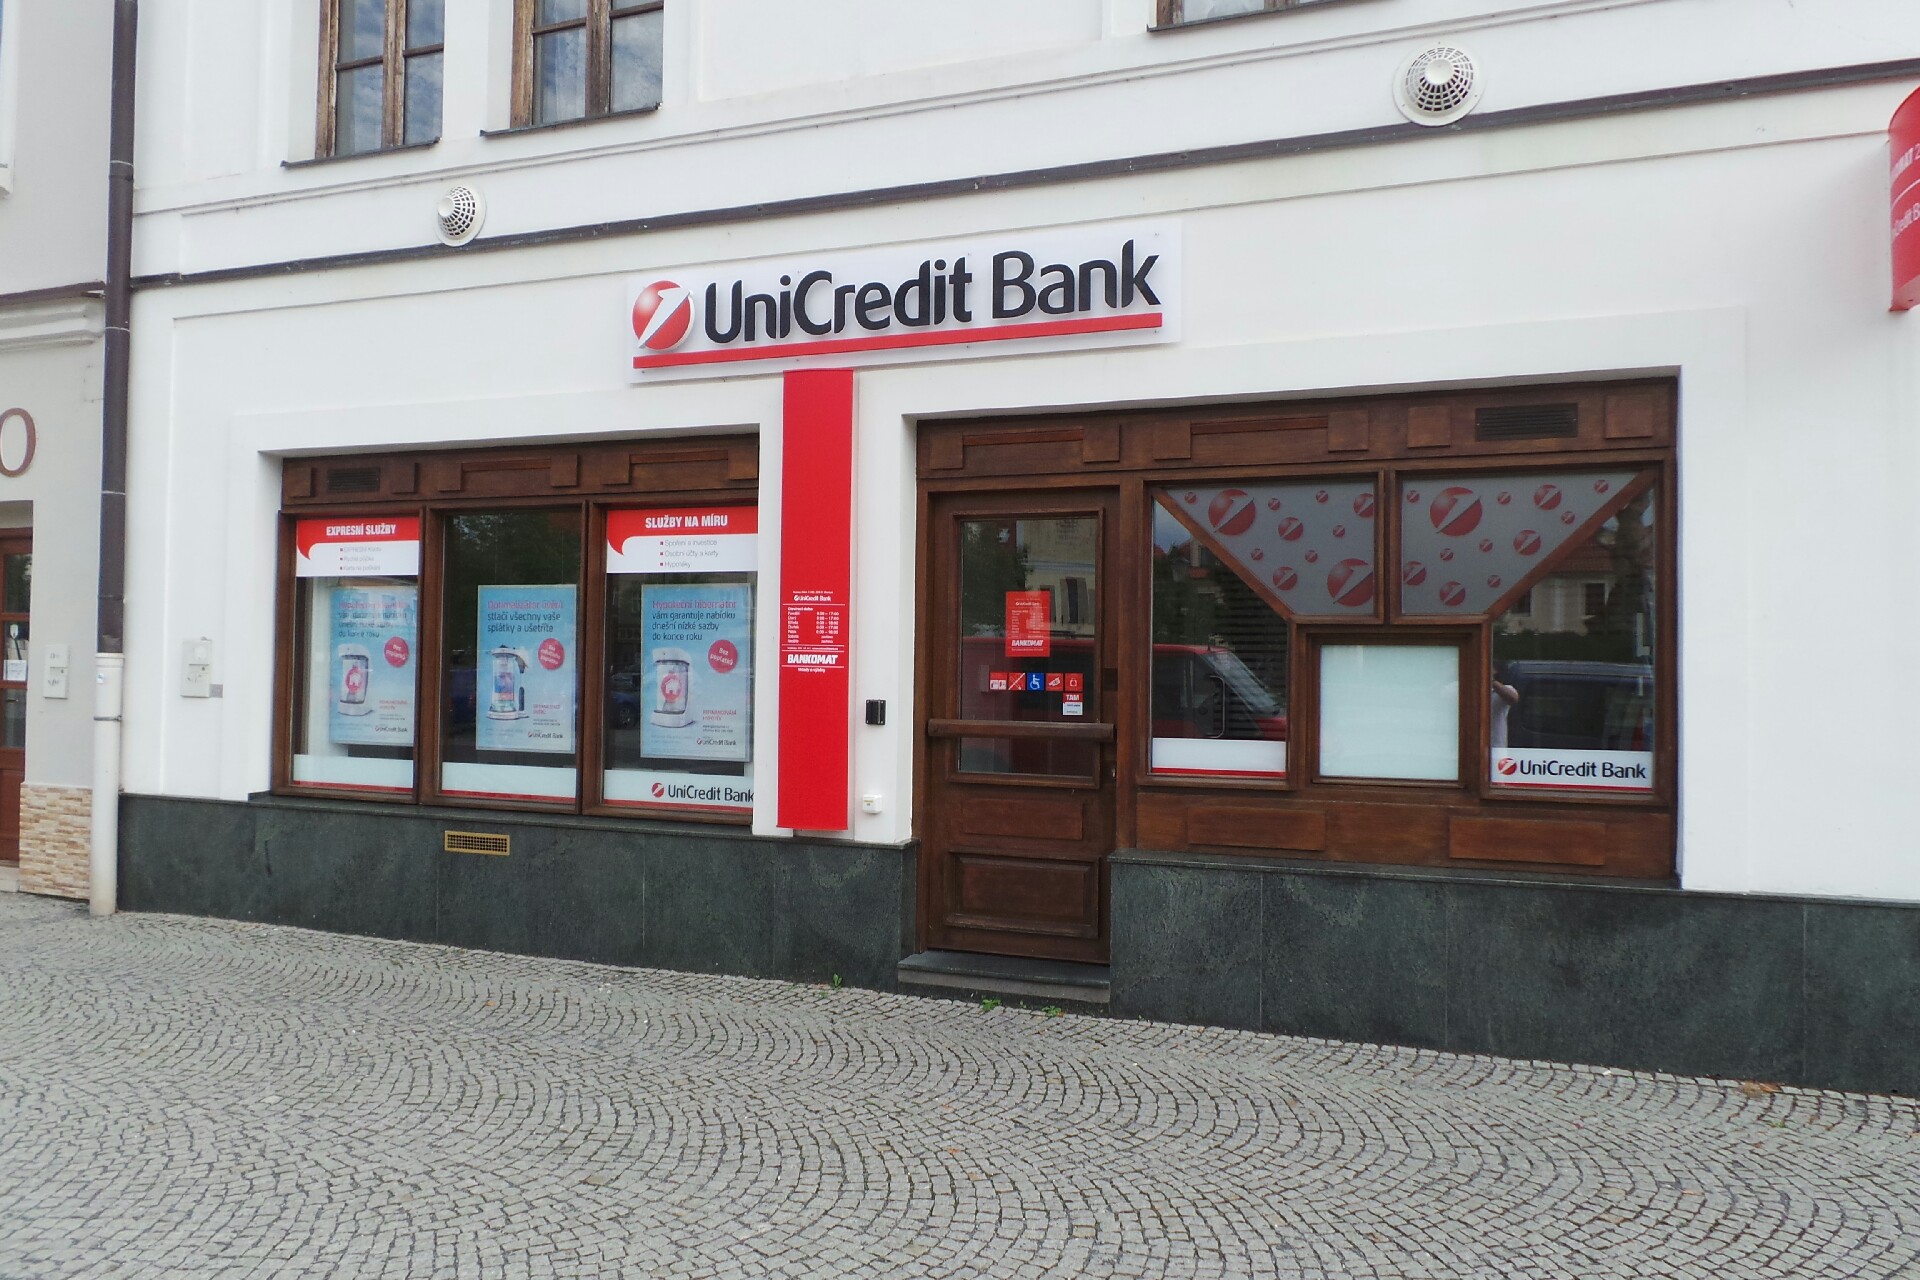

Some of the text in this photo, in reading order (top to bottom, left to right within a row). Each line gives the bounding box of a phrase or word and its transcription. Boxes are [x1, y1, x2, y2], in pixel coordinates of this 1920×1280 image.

[705, 239, 1161, 343] UniCredit Bank
[645, 513, 728, 528] SLUŽBY NA MÍRU
[326, 523, 396, 536] EXPRESNÍ SLUŽBY
[487, 611, 561, 622] stlačí všechny vaše
[669, 611, 704, 620] garantuje
[706, 611, 736, 619] nabídku
[487, 624, 515, 634] splátky
[652, 622, 719, 632] dnešní nízké sazby
[718, 647, 729, 655] Bez
[787, 654, 838, 665] BANKOMAT
[1520, 760, 1646, 779] UniCredit Bank
[668, 784, 754, 803] UniCredit Bank
